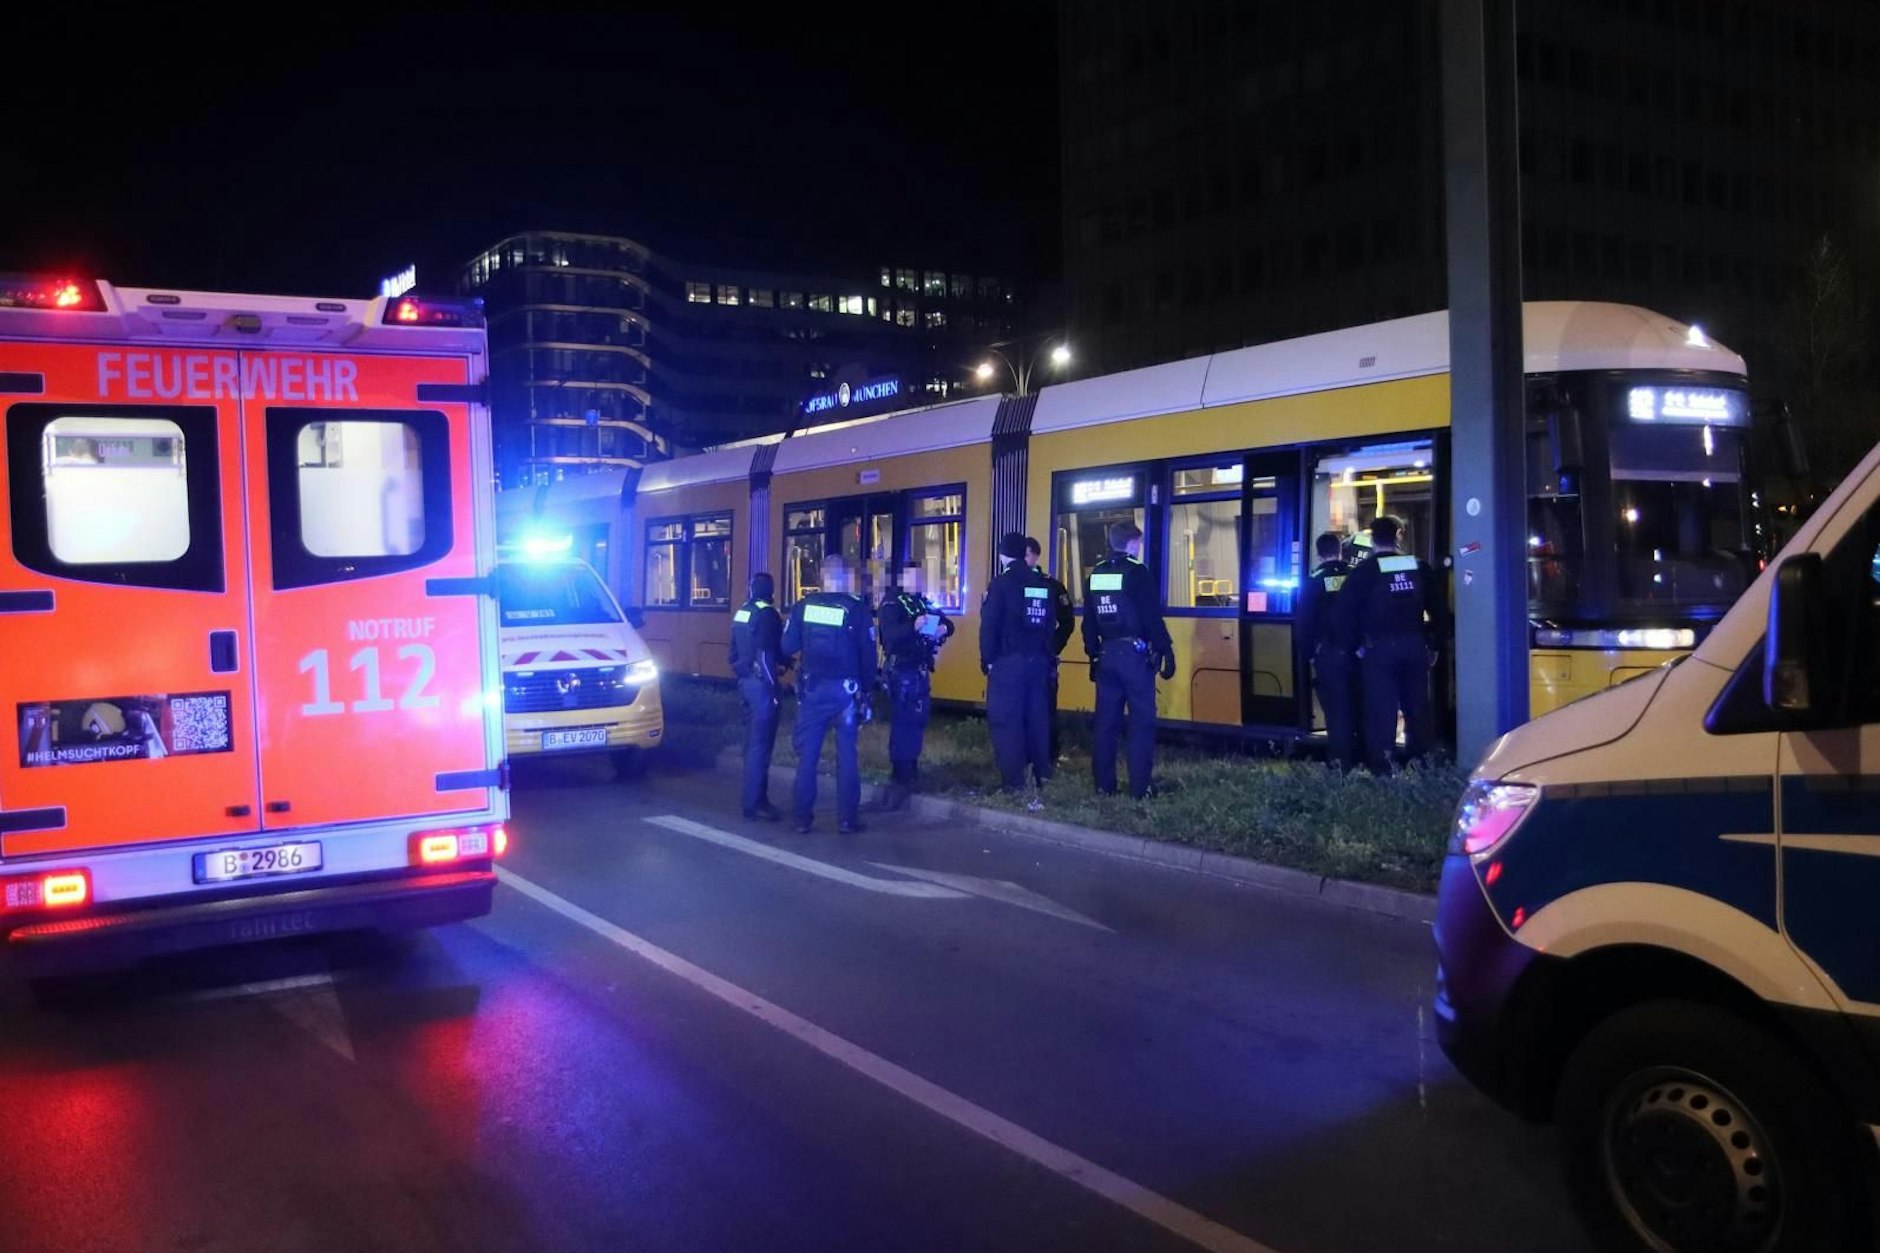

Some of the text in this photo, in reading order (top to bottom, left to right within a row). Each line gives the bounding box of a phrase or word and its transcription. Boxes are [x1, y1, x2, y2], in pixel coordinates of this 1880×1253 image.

[97, 352, 359, 401] FEUERWEHR
[348, 617, 435, 640] NOTRUF
[299, 643, 439, 715] 112
[27, 744, 140, 762] #HELMSUCHTKOPF
[224, 848, 302, 874] B 2986
